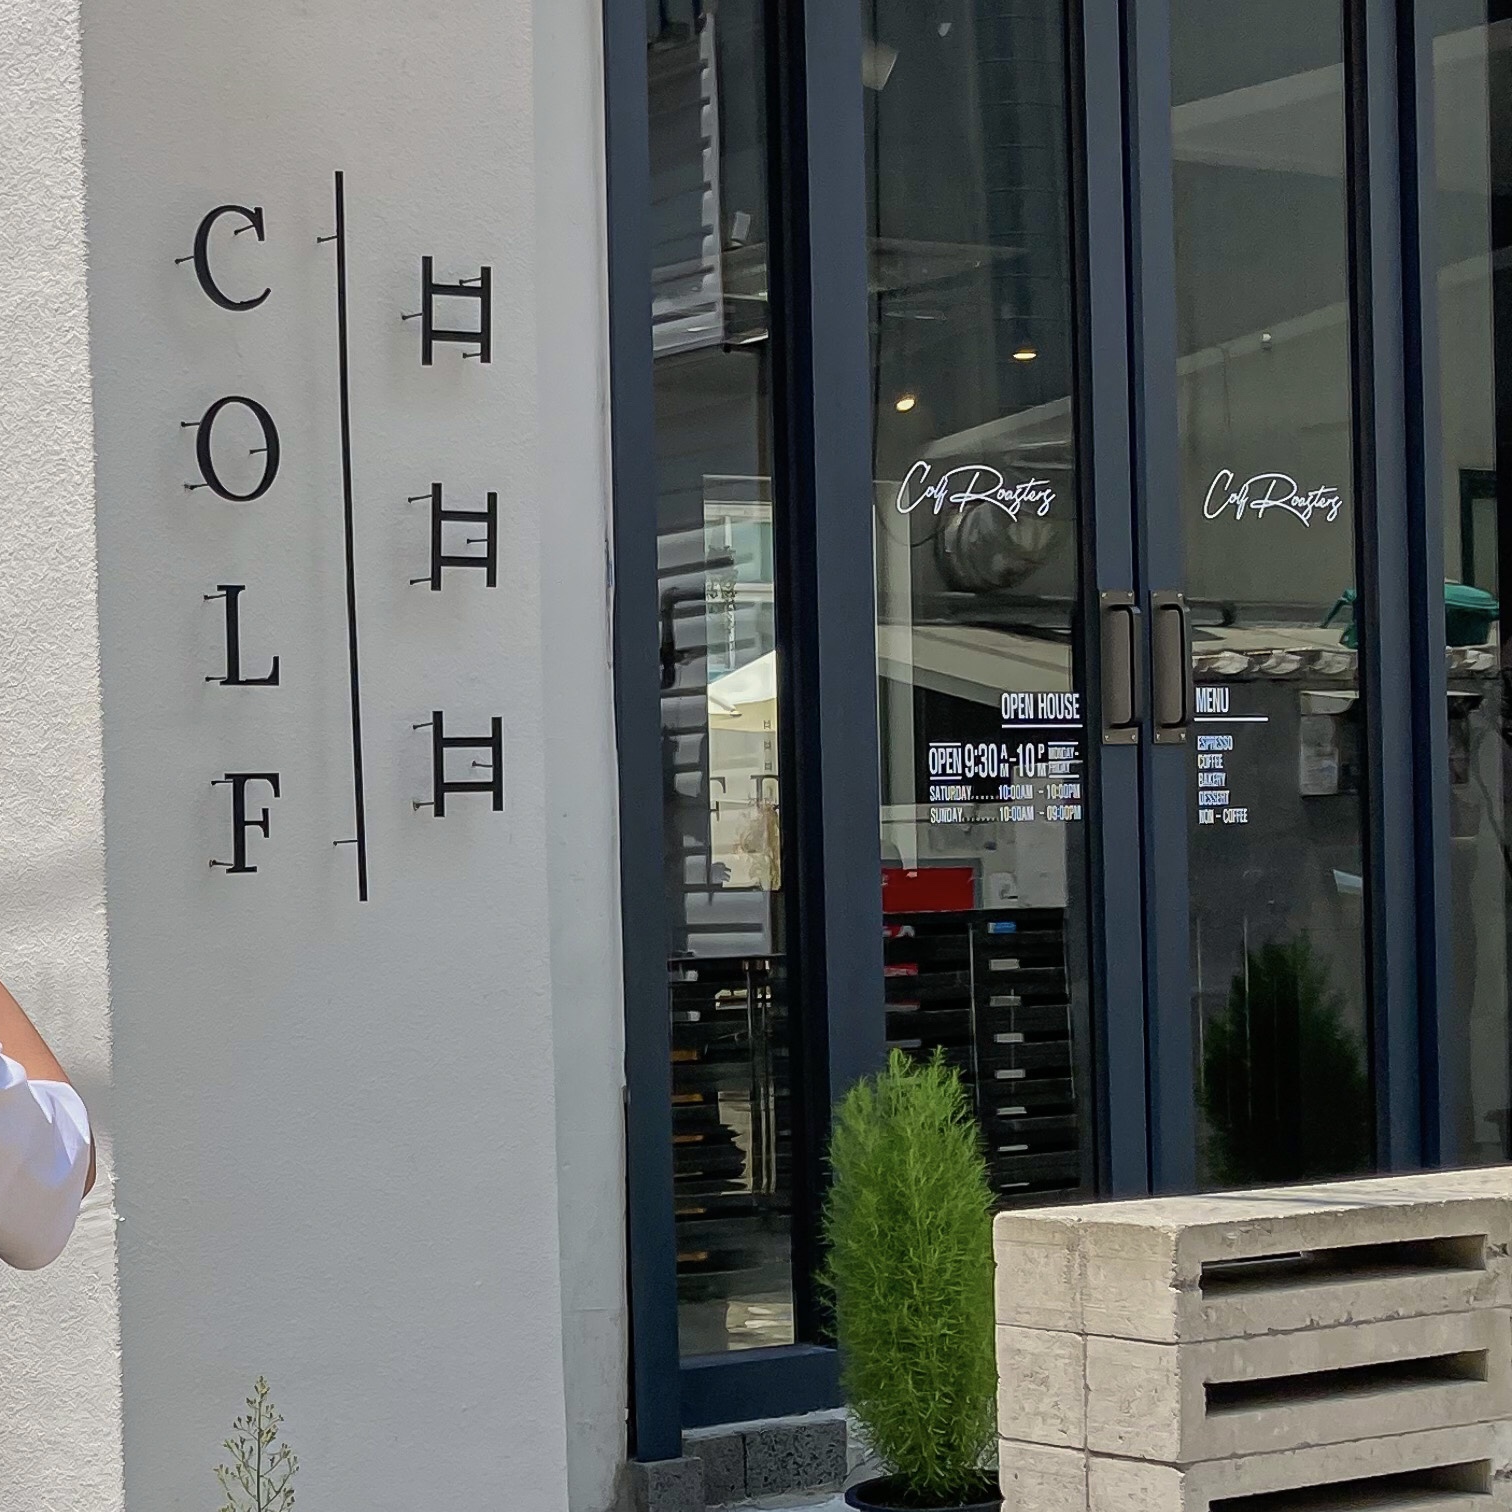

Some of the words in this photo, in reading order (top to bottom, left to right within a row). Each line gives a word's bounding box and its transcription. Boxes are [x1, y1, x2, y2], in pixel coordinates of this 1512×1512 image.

[896, 460, 949, 515] Colf
[945, 464, 1056, 523] Roasters
[1203, 469, 1249, 520] Colf
[1244, 473, 1343, 528] Roasters
[1001, 693, 1034, 720] OPEN
[1038, 692, 1080, 719] HOUSE
[1195, 687, 1229, 713] MENU
[929, 747, 963, 775] OPEN
[964, 743, 998, 778] 9:30
